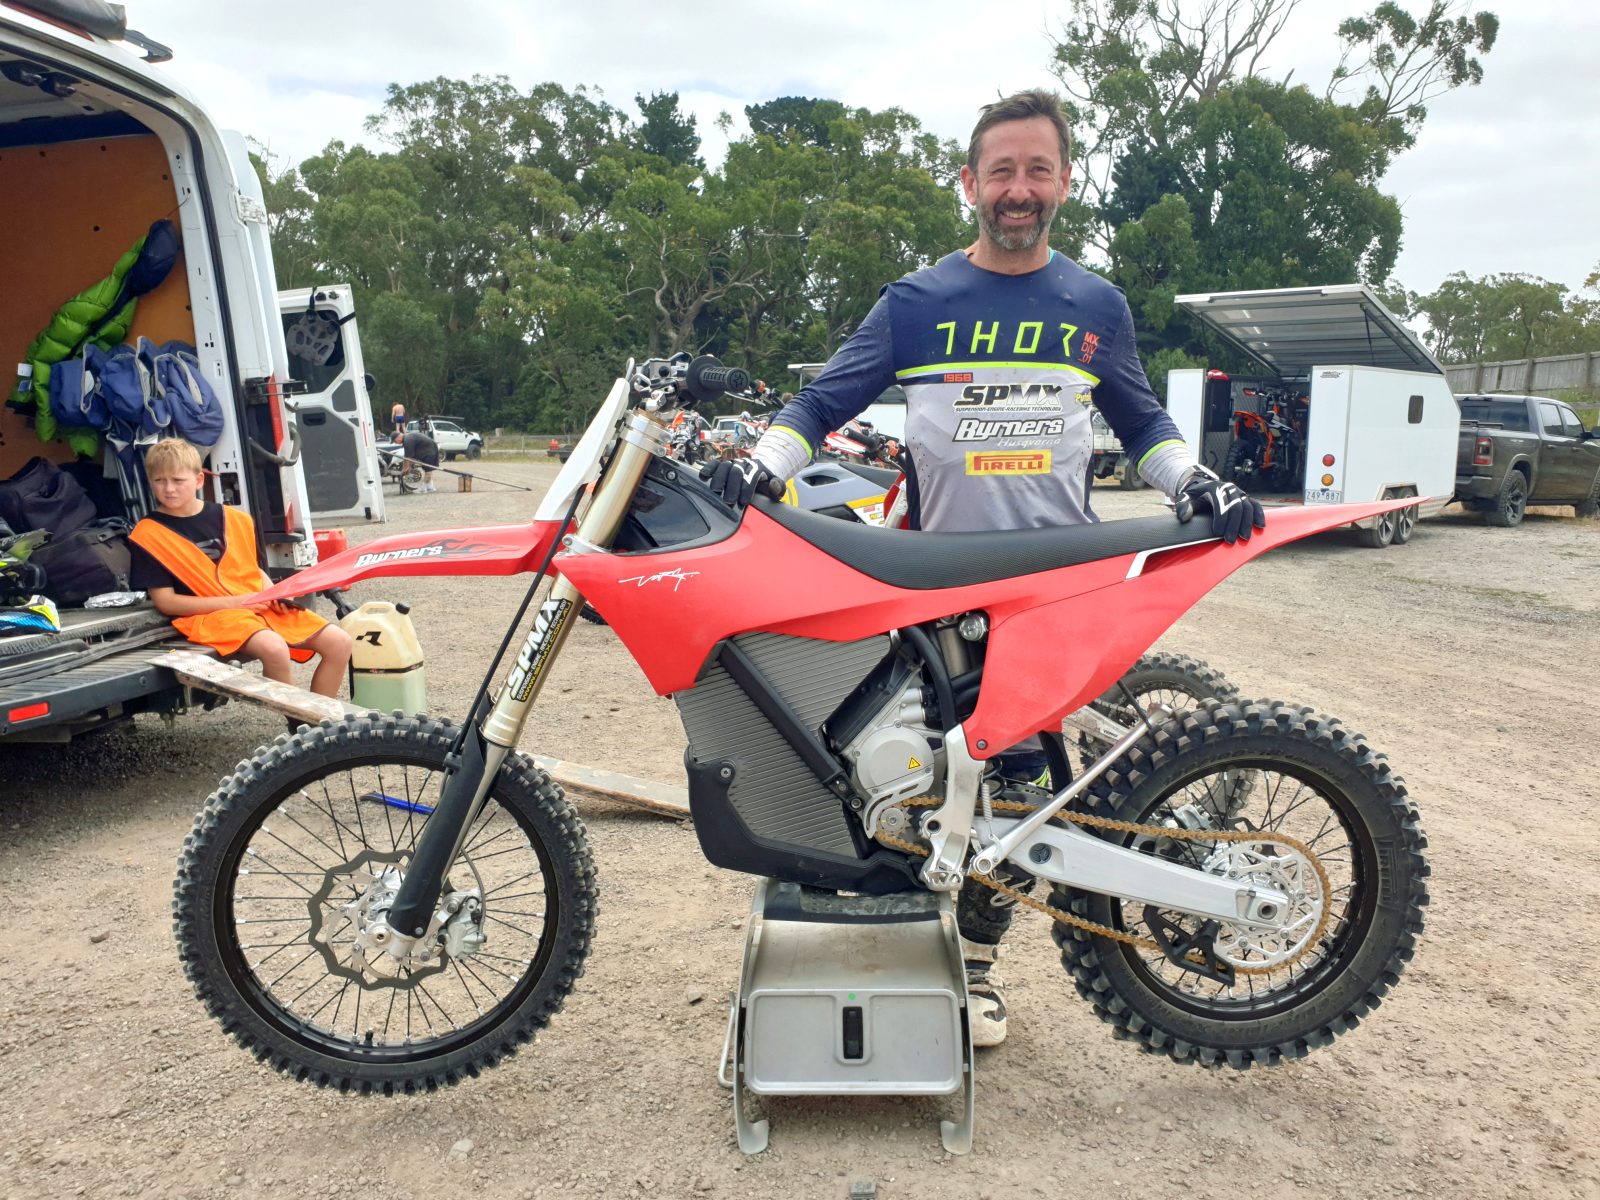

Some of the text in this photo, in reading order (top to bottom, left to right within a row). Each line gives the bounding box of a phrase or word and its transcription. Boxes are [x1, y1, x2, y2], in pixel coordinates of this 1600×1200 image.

[1084, 331, 1100, 346] MX
[1081, 341, 1098, 355] DIV
[954, 384, 1063, 406] SPMX
[973, 454, 1044, 471] PIRELLI
[507, 590, 561, 699] SPMX
